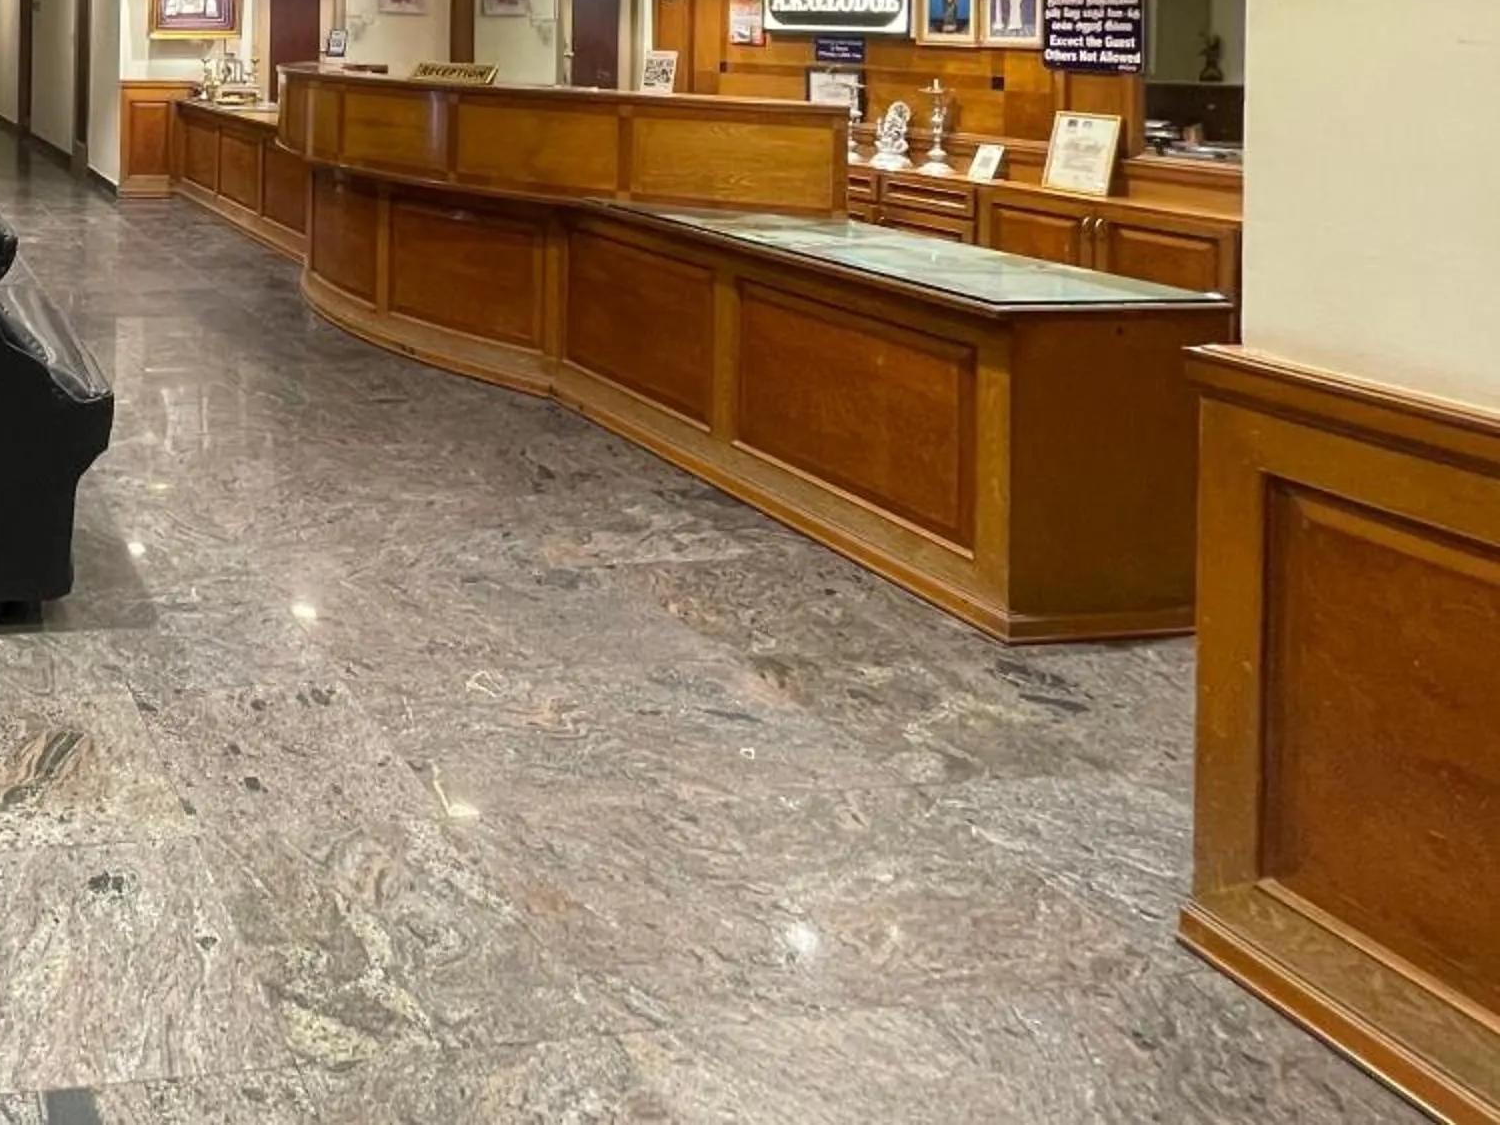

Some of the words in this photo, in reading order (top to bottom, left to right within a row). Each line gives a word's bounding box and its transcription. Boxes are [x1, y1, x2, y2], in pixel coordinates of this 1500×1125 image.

[1085, 36, 1102, 48] the
[1104, 36, 1135, 48] Guest
[1044, 49, 1077, 62] Others
[1079, 50, 1097, 62] Not
[1099, 51, 1141, 64] Allowed
[419, 64, 489, 79] RECEPTION
